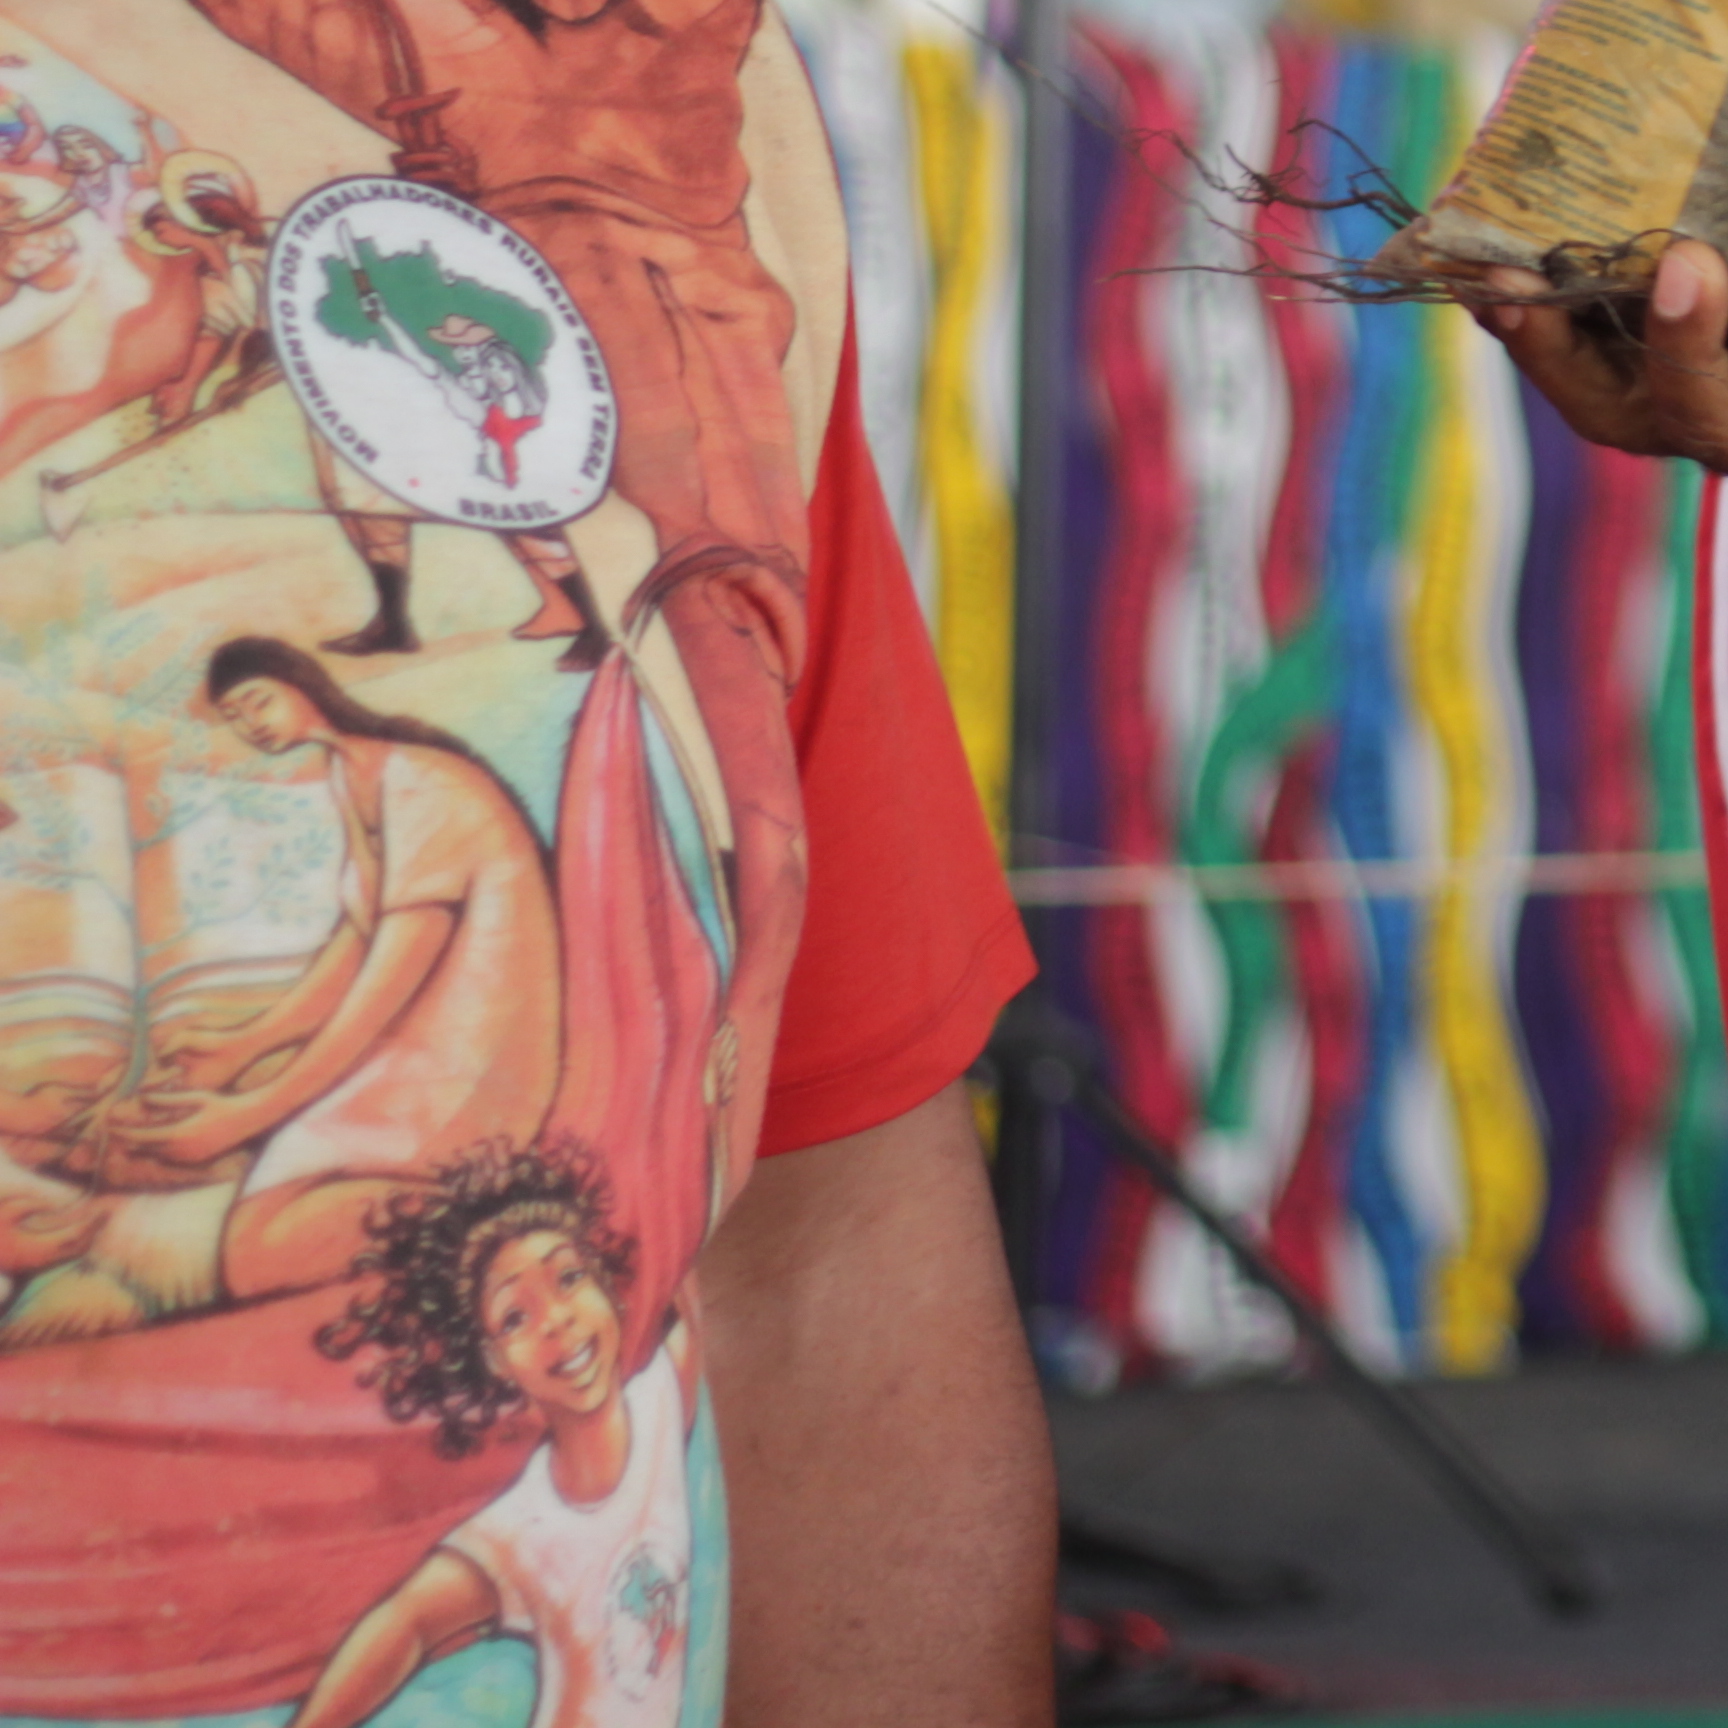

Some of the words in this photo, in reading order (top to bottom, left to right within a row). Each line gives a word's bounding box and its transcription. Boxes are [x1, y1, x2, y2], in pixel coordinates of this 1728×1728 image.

[291, 182, 494, 242] TRABALHADORES
[278, 242, 303, 293] DOS
[500, 232, 580, 328] RURAIS
[278, 299, 380, 464] MOVIMENTO
[457, 495, 560, 522] BRASIL
